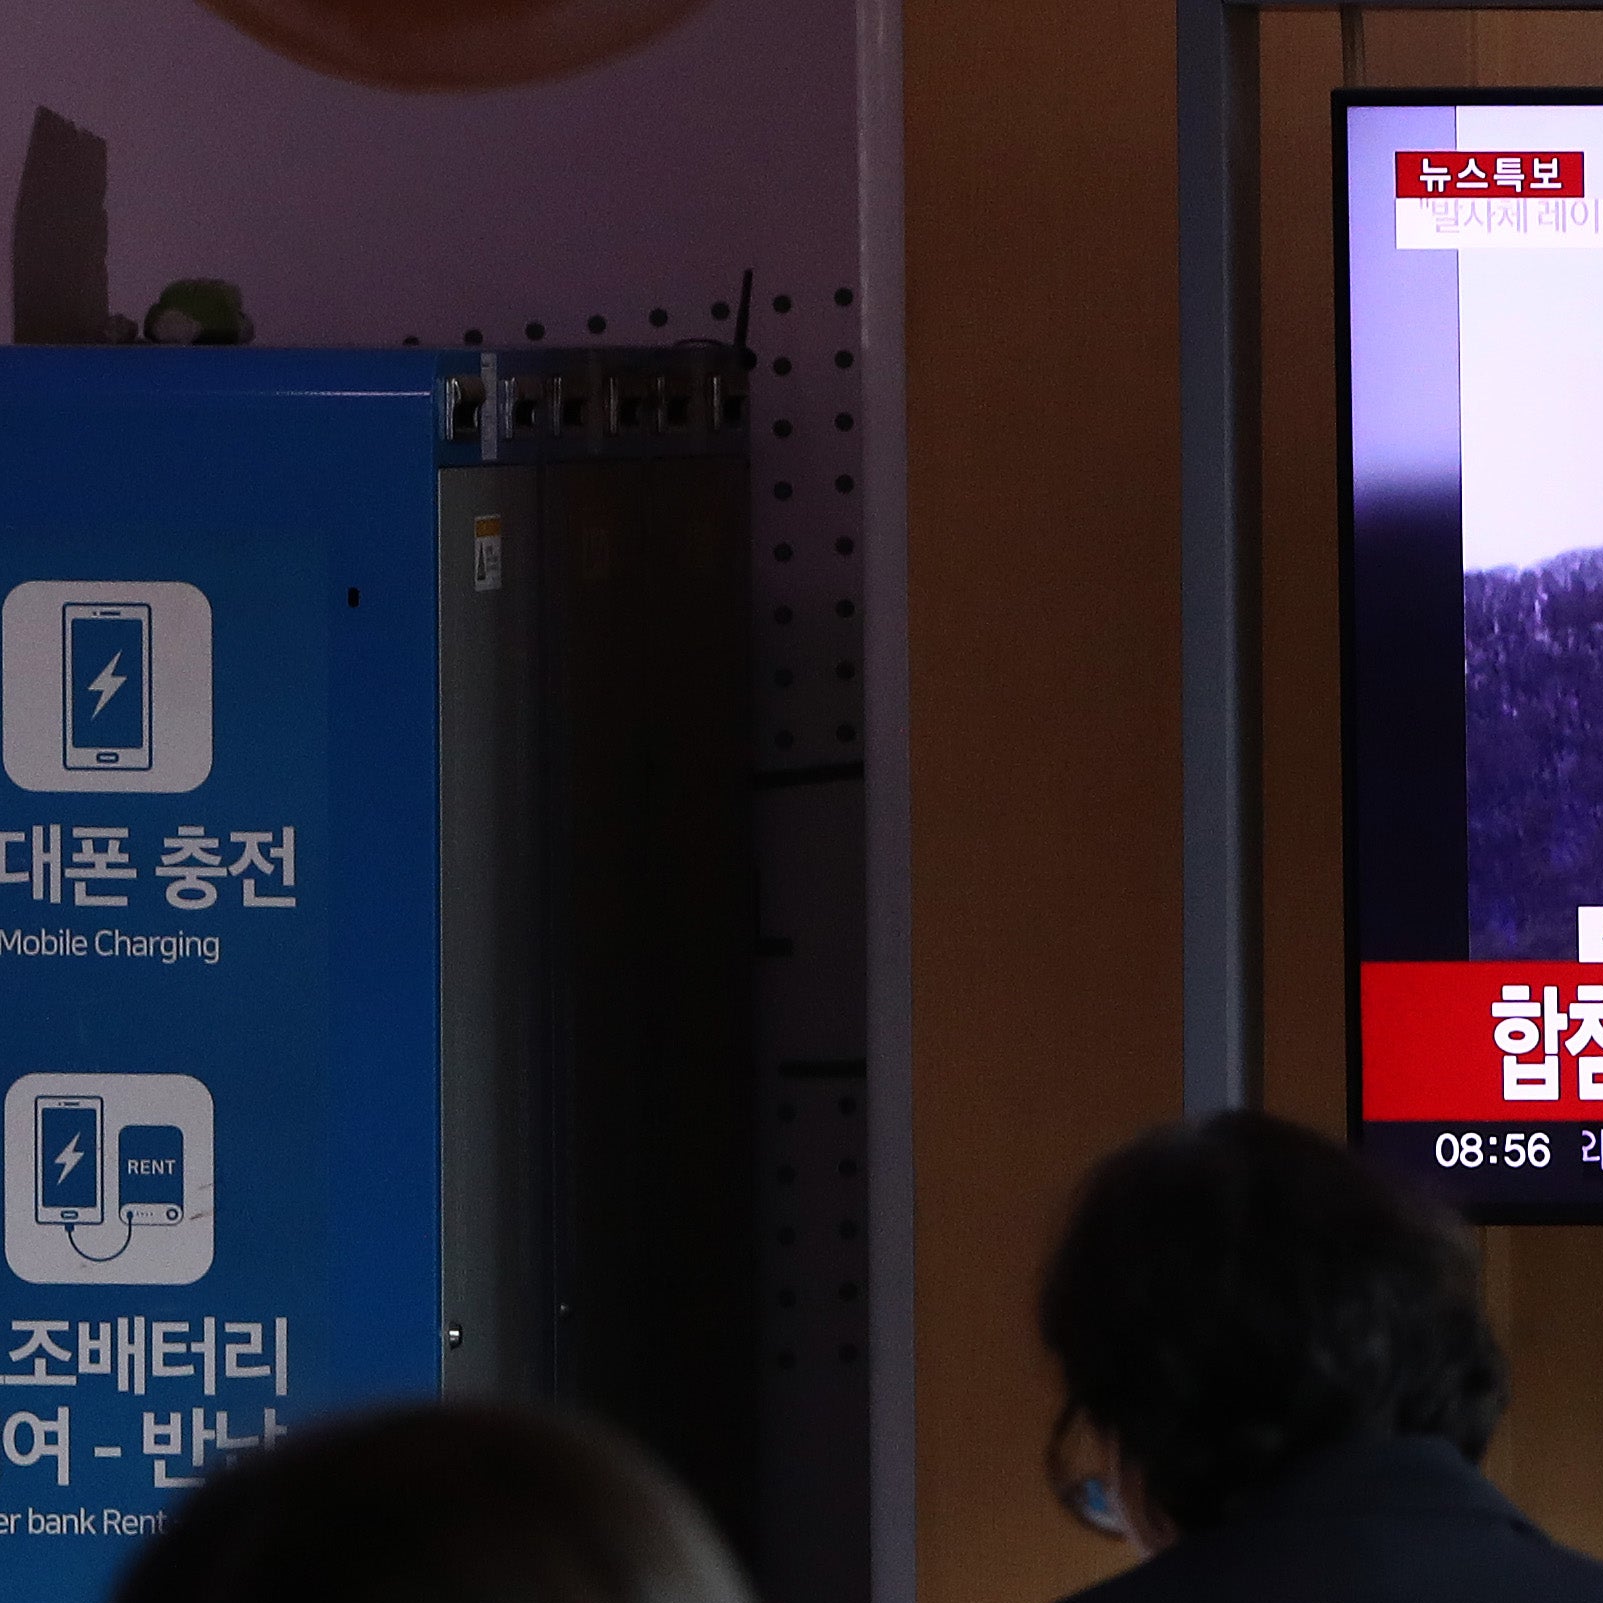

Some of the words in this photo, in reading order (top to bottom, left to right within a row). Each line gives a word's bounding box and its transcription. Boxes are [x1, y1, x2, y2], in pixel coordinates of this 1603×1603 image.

[1418, 157, 1563, 193] 뉴스특보
[1419, 197, 1528, 234] "발사체
[0, 824, 137, 907] 대폰
[155, 825, 297, 910] 충전
[0, 928, 88, 957] Mobile
[94, 928, 220, 964] Charging
[127, 1158, 176, 1175] RENT
[1435, 1131, 1551, 1168] 08:56
[0, 1316, 288, 1396] 조배터리
[2, 1406, 70, 1486] 여
[28, 1507, 97, 1535] bank
[103, 1508, 168, 1536] Rent
